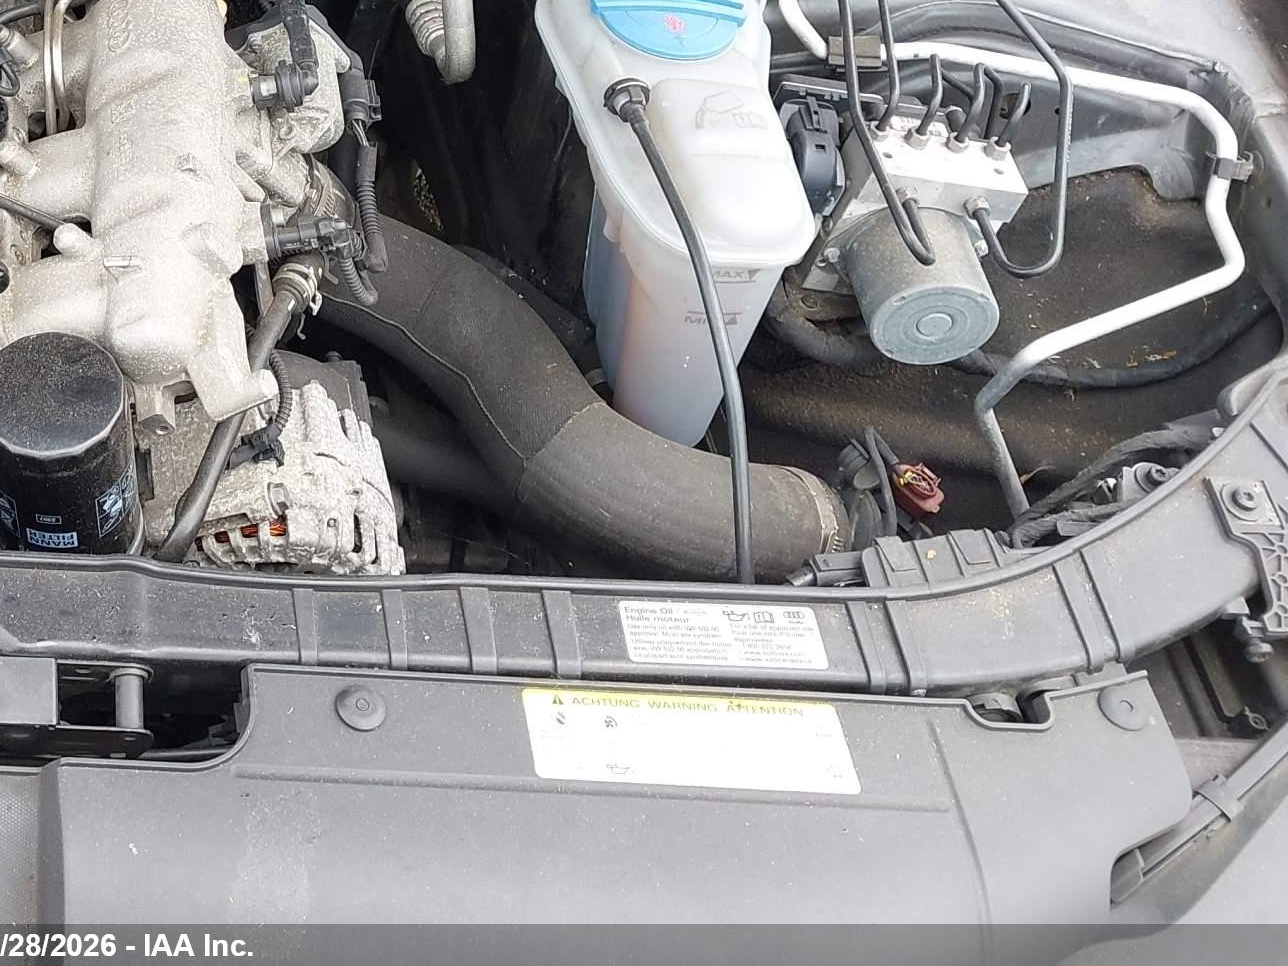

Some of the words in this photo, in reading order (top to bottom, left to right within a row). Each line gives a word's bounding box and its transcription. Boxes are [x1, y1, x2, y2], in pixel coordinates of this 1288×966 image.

[29, 530, 74, 541] FILTER
[30, 536, 75, 546] MANN
[624, 606, 657, 616] Engine
[571, 696, 640, 709] ACHTUNG
[647, 700, 718, 713] WARNING
[727, 703, 805, 717] ATTENTION
